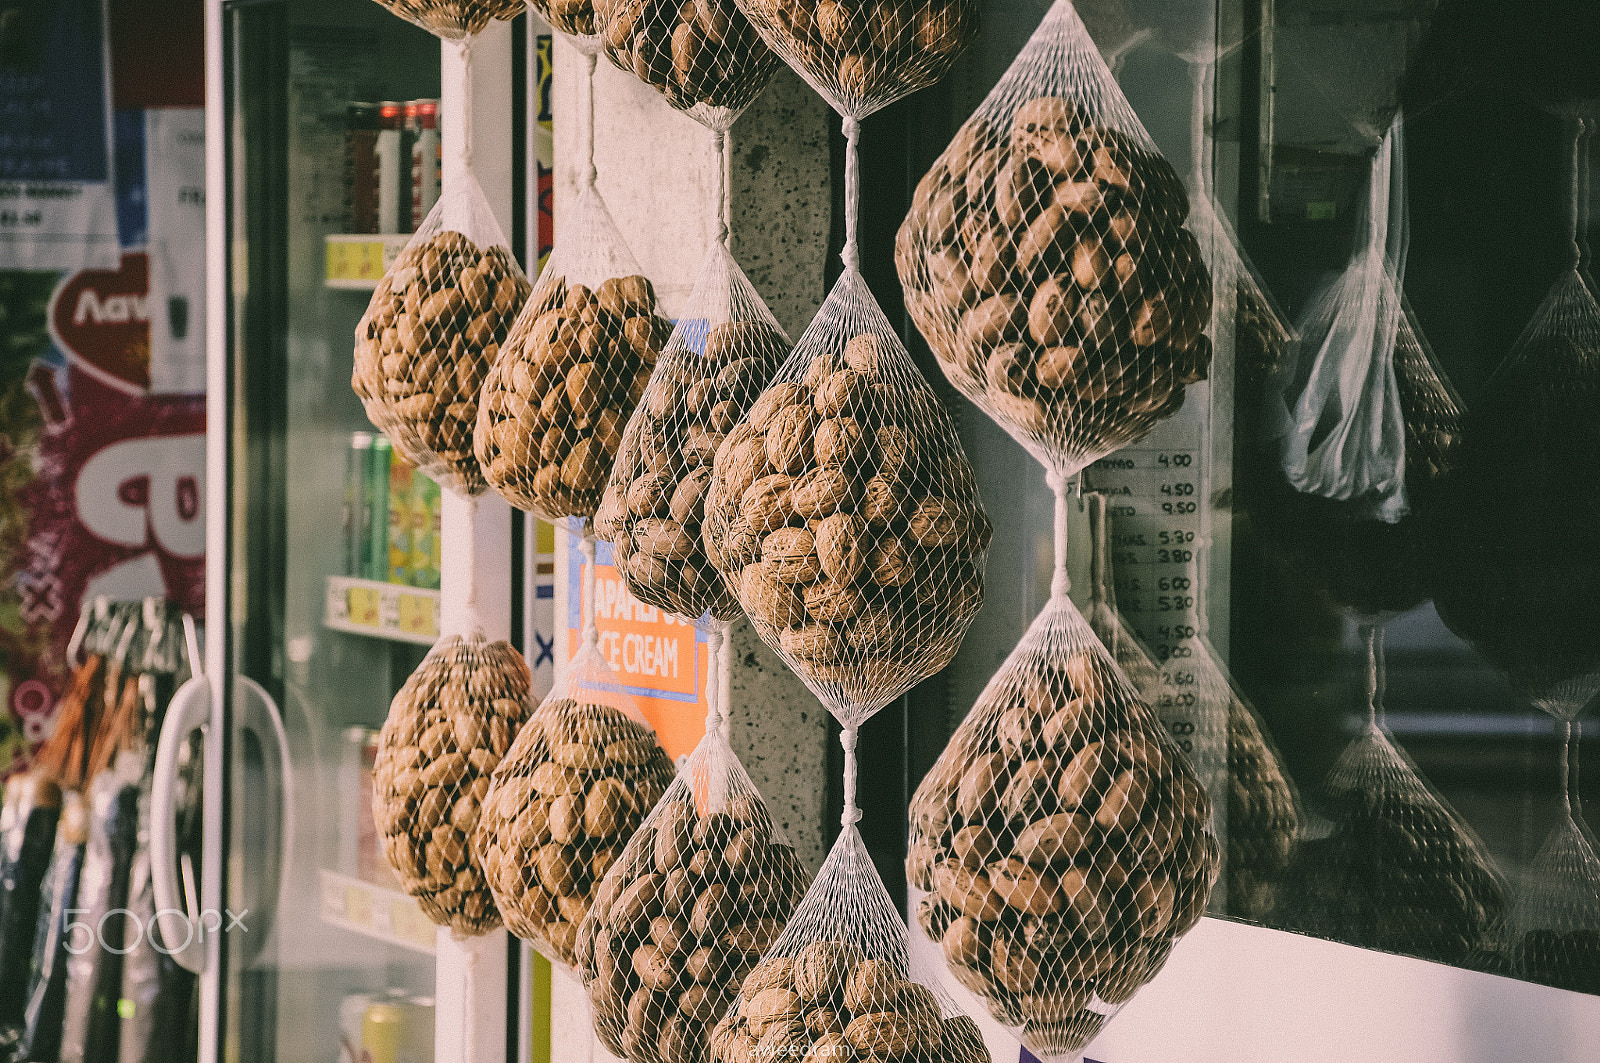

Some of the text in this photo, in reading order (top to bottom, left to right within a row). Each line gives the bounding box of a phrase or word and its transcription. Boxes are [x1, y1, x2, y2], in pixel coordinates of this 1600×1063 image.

[1157, 453, 1192, 468] 4.00
[1160, 482, 1194, 497] 4.50
[1161, 501, 1197, 515] 9.50
[1158, 530, 1195, 545] 5.30
[596, 630, 678, 678] CE CREAM
